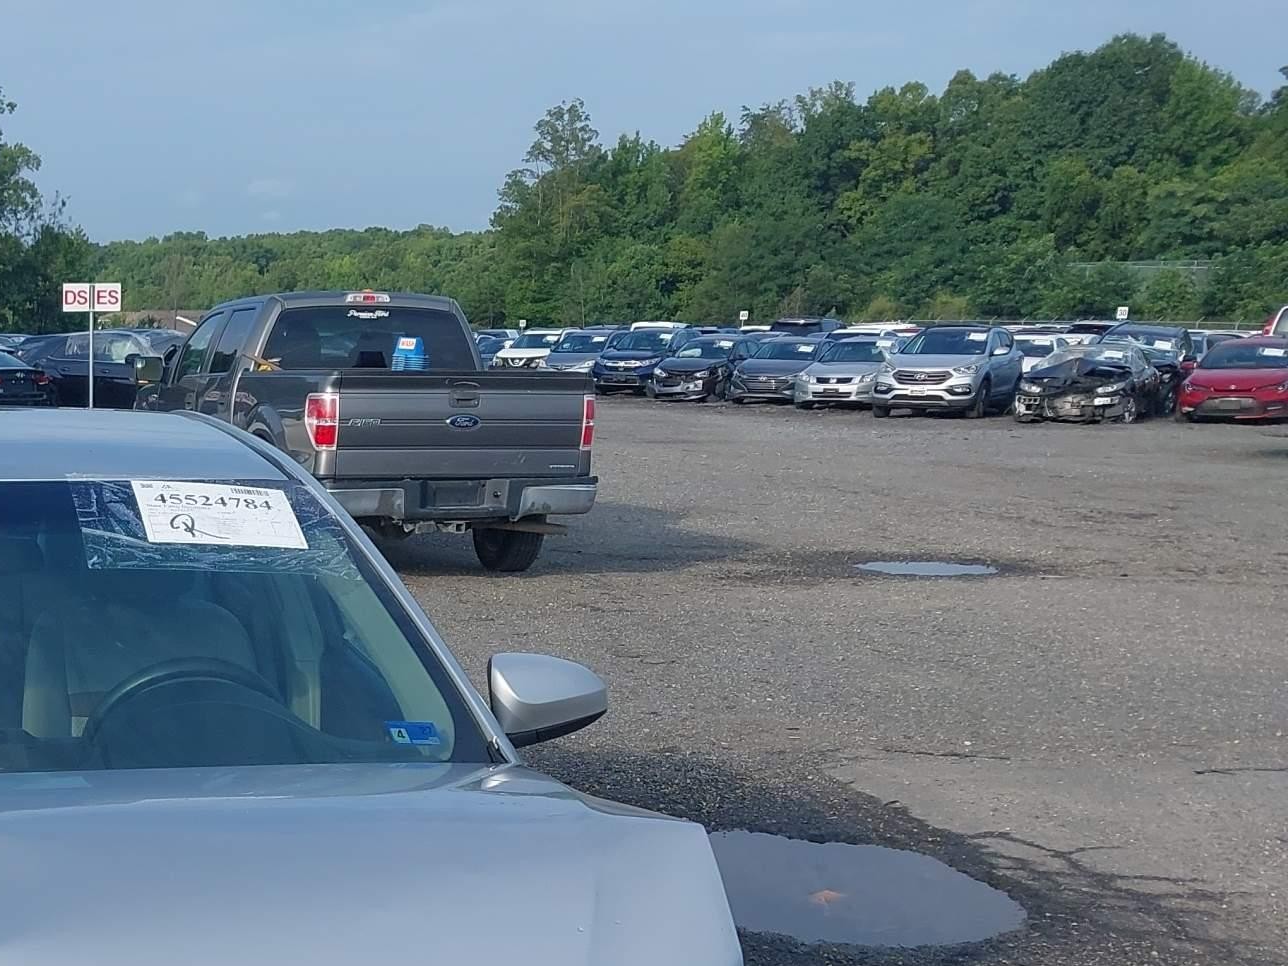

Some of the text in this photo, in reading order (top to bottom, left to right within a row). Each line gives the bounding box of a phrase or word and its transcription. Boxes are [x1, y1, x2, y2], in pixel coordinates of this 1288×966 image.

[64, 289, 88, 305] DS
[96, 289, 119, 305] ES
[153, 493, 273, 511] 45524784
